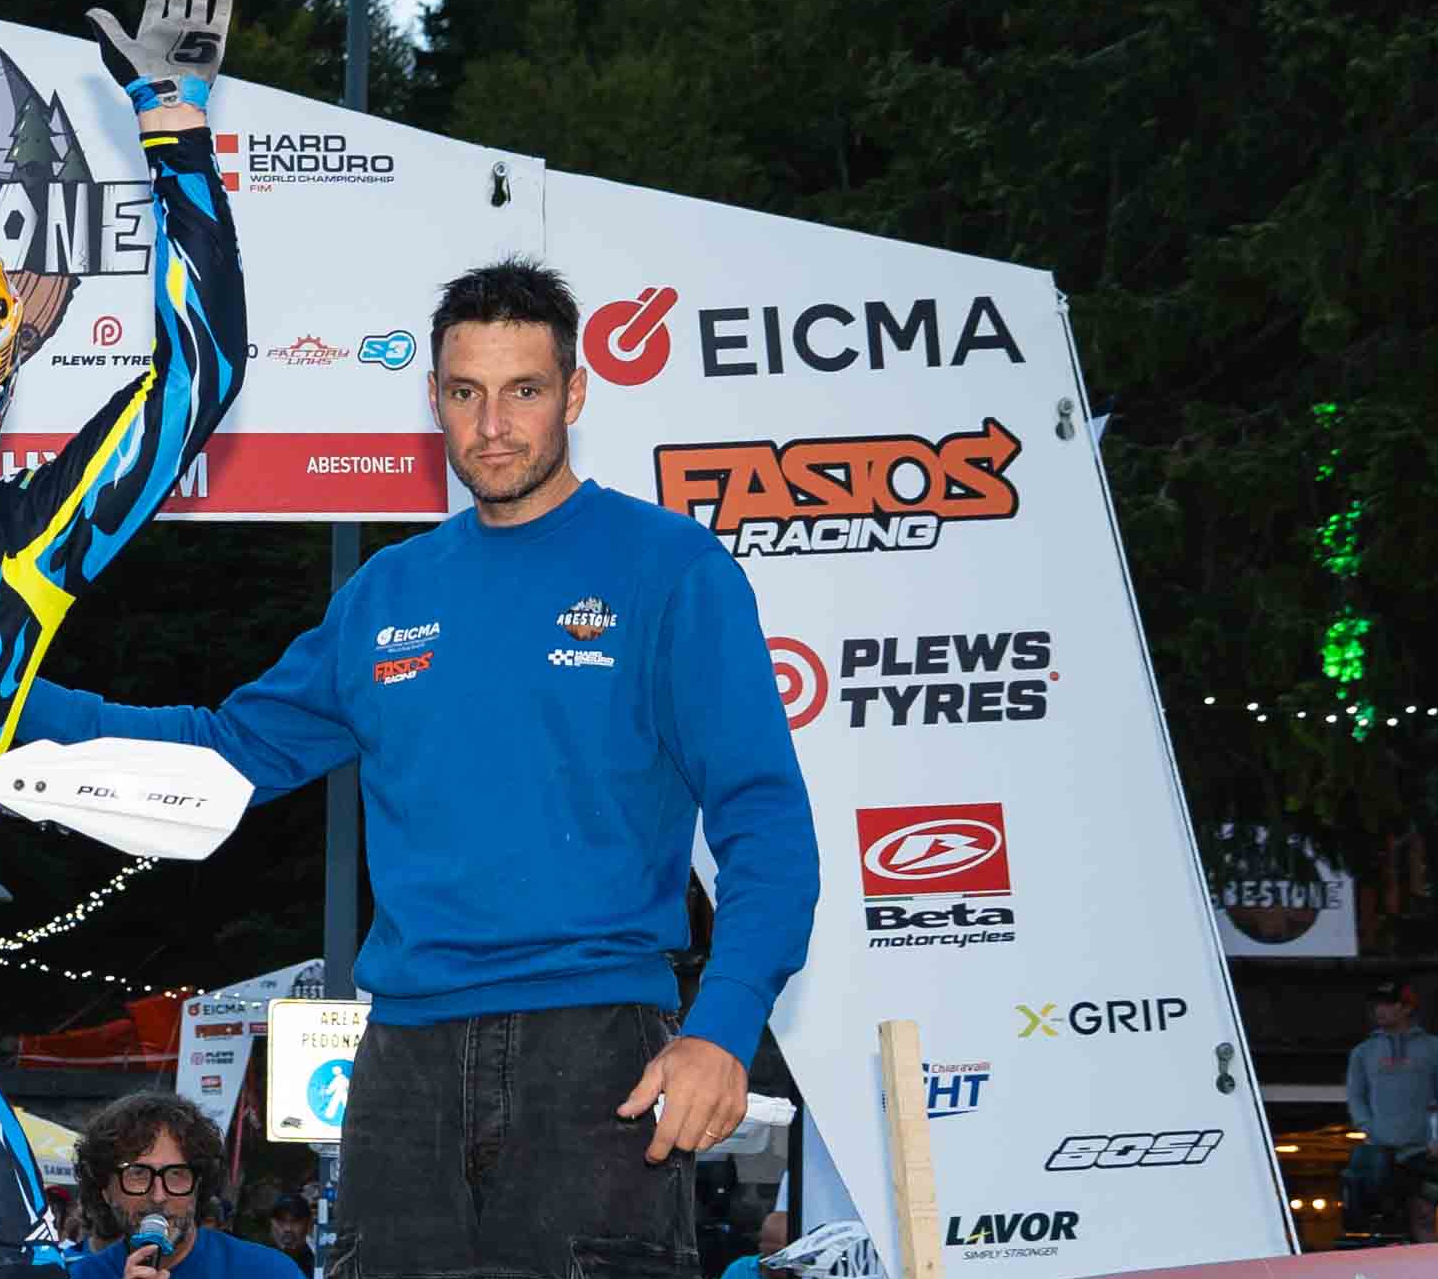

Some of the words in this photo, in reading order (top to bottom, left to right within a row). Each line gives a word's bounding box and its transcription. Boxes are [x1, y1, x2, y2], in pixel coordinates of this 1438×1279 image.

[249, 134, 346, 152] HARD
[249, 154, 394, 173] ENDURO
[250, 175, 295, 183] WORLD
[297, 175, 395, 183] CHAMPIONSHIP
[249, 184, 273, 193] FIM
[699, 295, 1026, 378] EICMA
[51, 355, 108, 366] PLEWS
[111, 356, 152, 366] TYRE
[306, 456, 415, 474] ABESTONE.IT
[730, 515, 940, 557] RACING
[556, 612, 617, 627] ABESTONE
[393, 622, 440, 643] EICMA
[840, 630, 1051, 677] PLEWS
[841, 680, 1049, 728] TYRES
[866, 903, 1015, 931] Beta
[869, 930, 1016, 948] motorcycles
[320, 1011, 361, 1025] AREA
[301, 1032, 360, 1049] PEDONA
[924, 1074, 990, 1109] HT
[945, 1211, 1080, 1246] LAVOR
[962, 1249, 1001, 1261] SIMPLY
[1003, 1247, 1058, 1259] STRONGER
